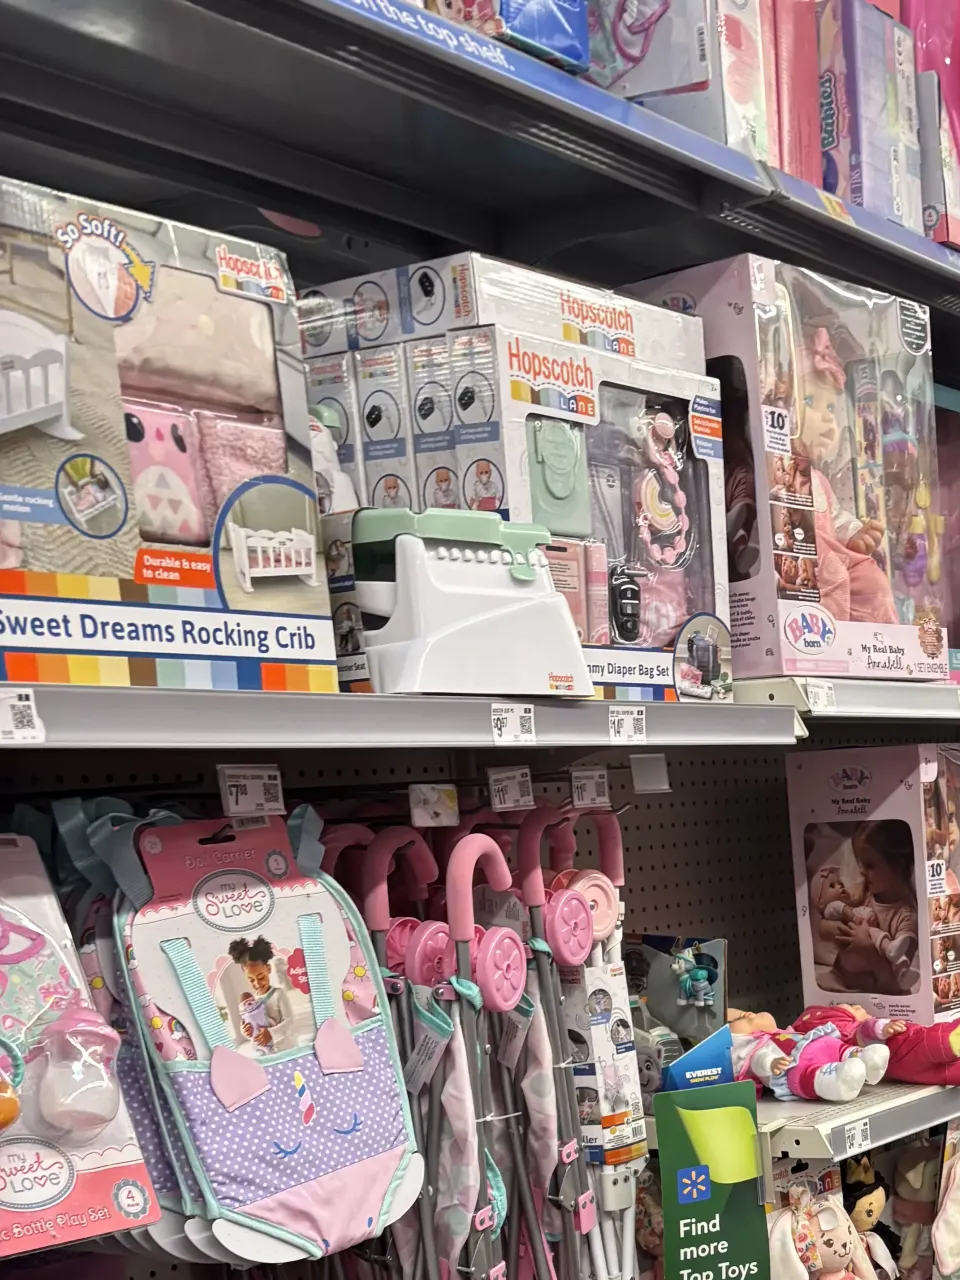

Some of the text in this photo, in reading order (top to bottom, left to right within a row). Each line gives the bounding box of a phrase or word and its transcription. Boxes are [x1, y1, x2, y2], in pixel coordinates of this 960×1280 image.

[416, 14, 458, 49] top
[459, 33, 515, 71] shelf.
[57, 213, 125, 249] So Soft!
[560, 290, 634, 334] Hopscotch
[508, 337, 594, 391] Hopscotch
[560, 397, 595, 415] LANE
[142, 568, 180, 581] to clean
[143, 554, 181, 569] Durable
[190, 560, 211, 575] easy
[80, 613, 175, 643] Dreams
[182, 620, 270, 653] Rocking
[275, 625, 316, 650] Crib
[787, 612, 834, 644] BABY
[803, 637, 821, 648] born
[872, 644, 888, 654] Real
[889, 645, 905, 656] Baby
[607, 663, 670, 680] Diaper Bag Set
[212, 849, 257, 865] Carrier
[220, 882, 236, 893] my
[204, 882, 267, 917] Sweet
[686, 1067, 722, 1079] EVEREST
[8, 1152, 26, 1164] my
[126, 1190, 136, 1202] 4
[12, 1207, 111, 1238] Bottle Play Set
[679, 1214, 721, 1238] Find
[679, 1240, 729, 1261] more
